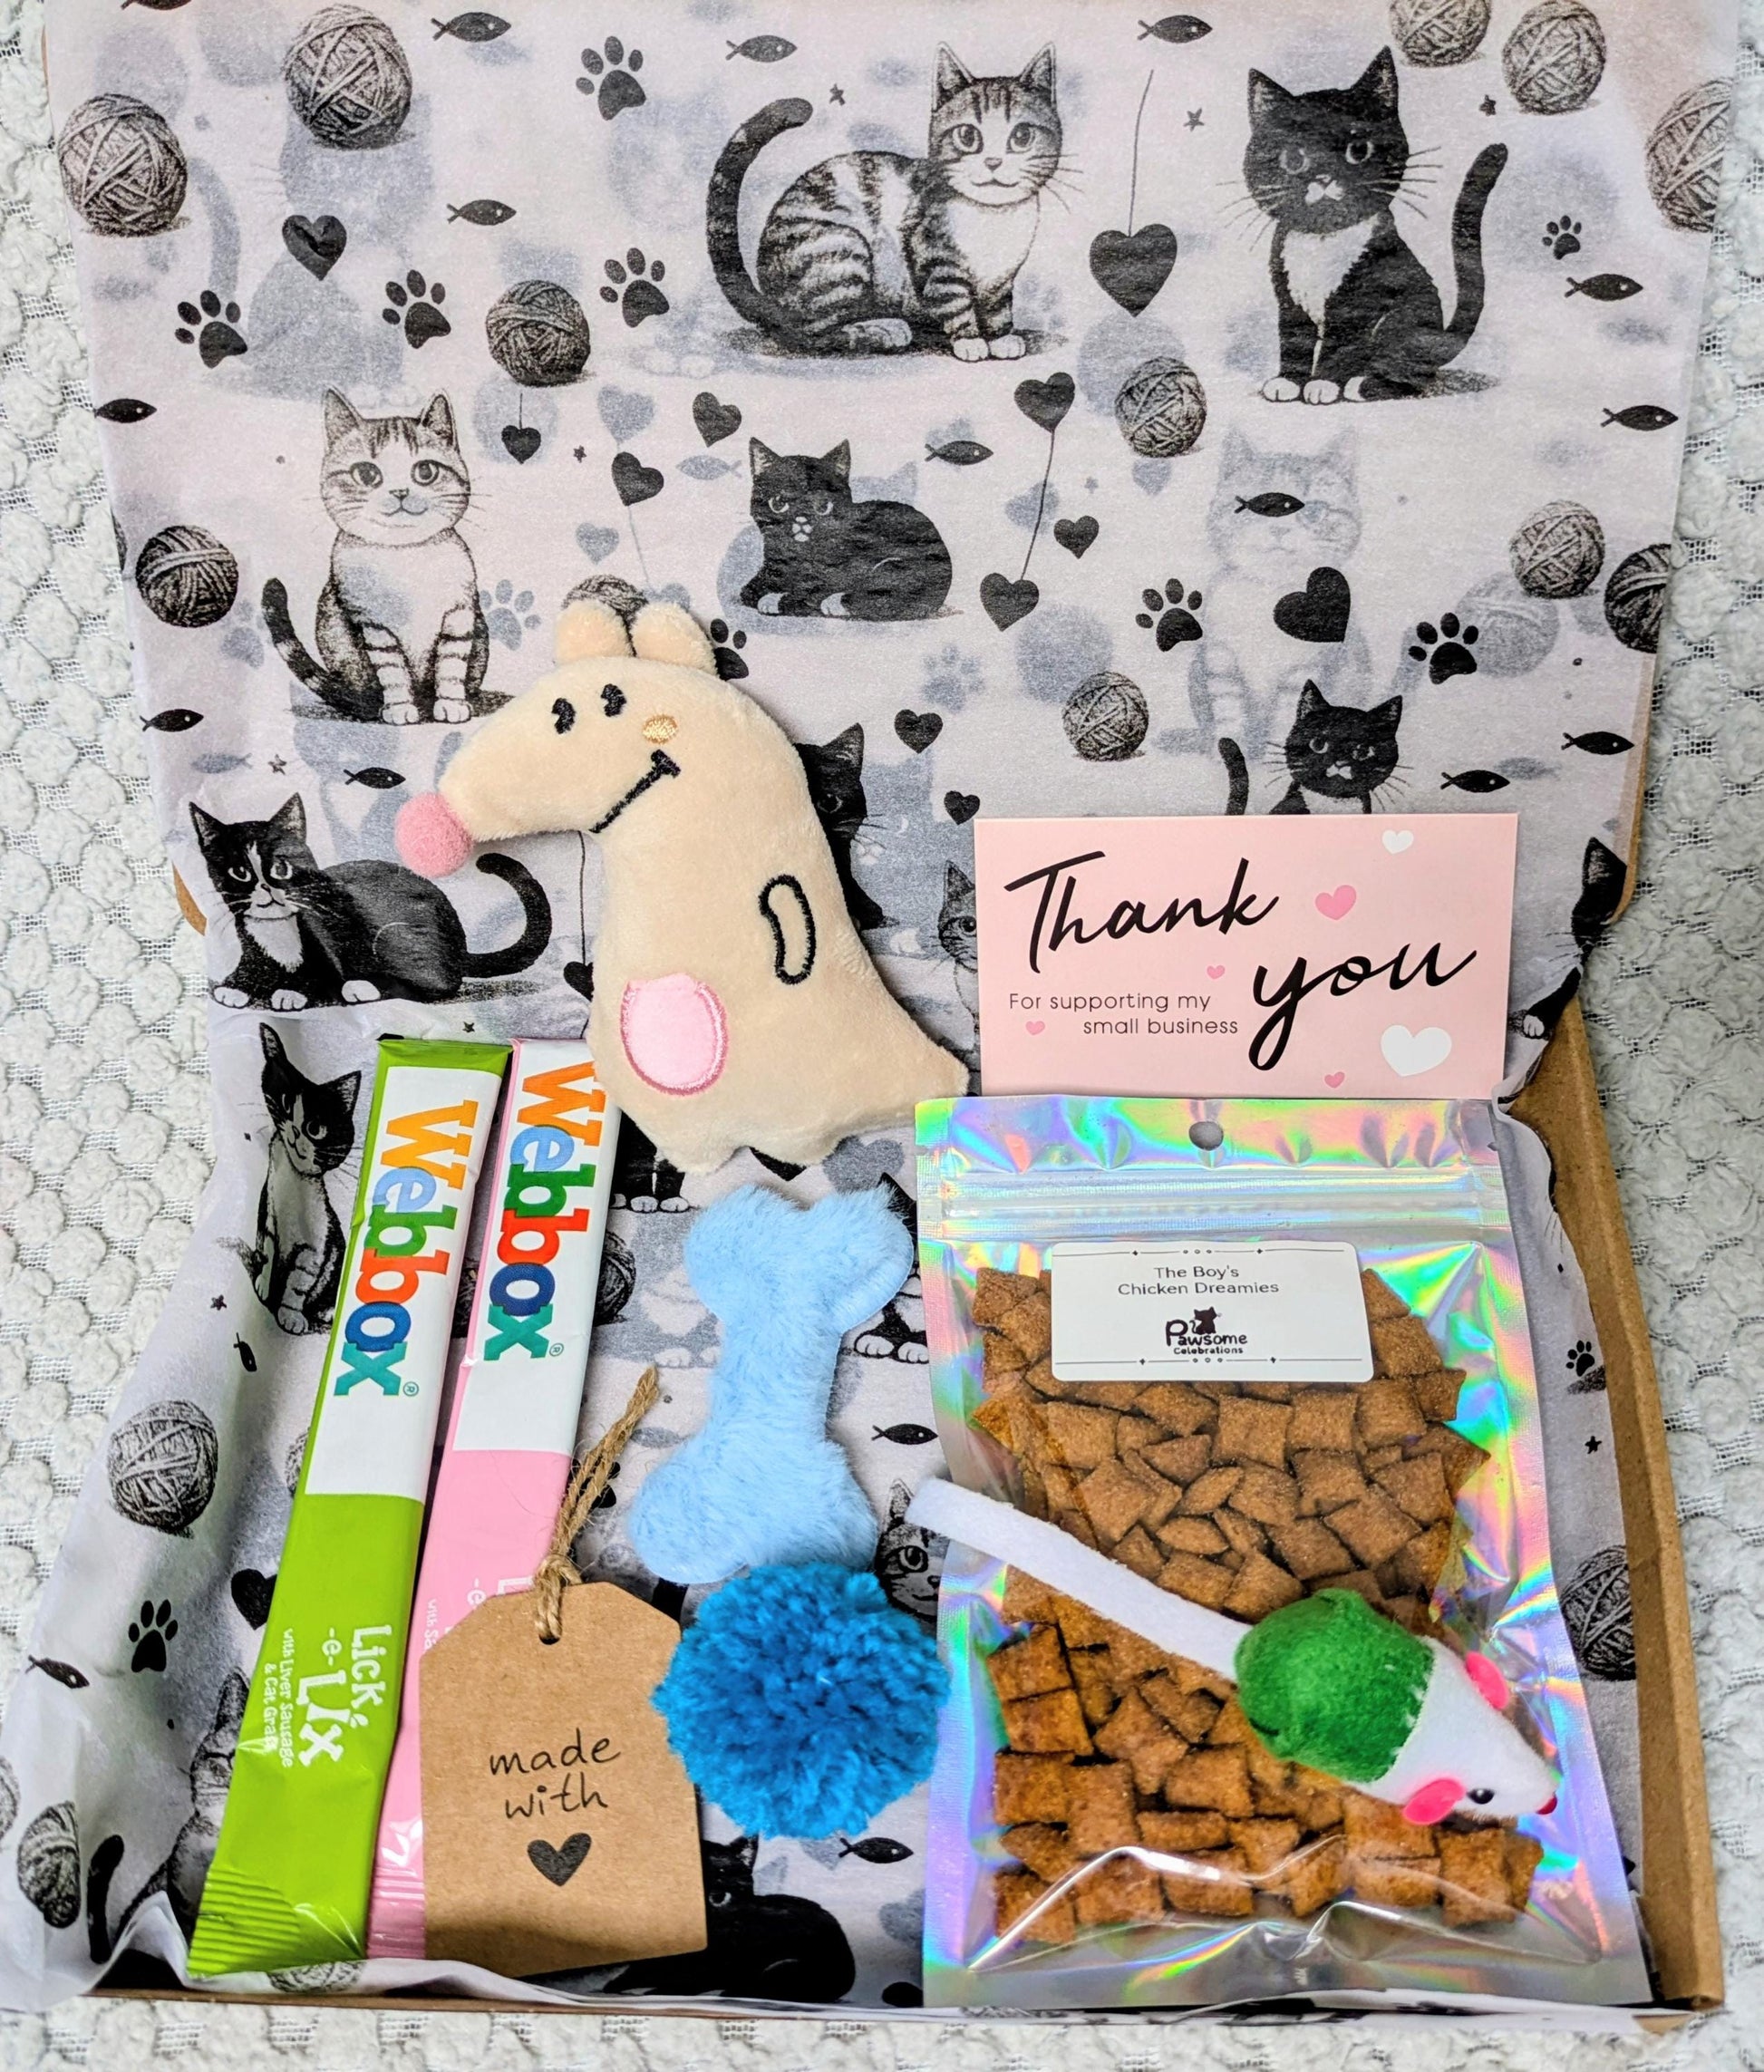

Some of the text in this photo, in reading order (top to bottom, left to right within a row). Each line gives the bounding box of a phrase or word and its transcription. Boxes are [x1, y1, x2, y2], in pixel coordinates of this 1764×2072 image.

[1003, 850, 1279, 973] Thank
[1009, 992, 1211, 1013] For supporting my
[1248, 943, 1478, 1071] you
[1083, 1017, 1238, 1035] small business
[1153, 1265, 1239, 1280] The Boy's
[1118, 1282, 1279, 1295] Chicken Dreamies
[1166, 1318, 1247, 1347] Pawsome
[1173, 1347, 1244, 1355] Celebrations
[425, 1598, 438, 1628] with
[265, 1662, 277, 1675] &
[351, 1624, 393, 1709] Lick
[263, 1677, 279, 1705] Cat
[279, 1628, 295, 1767] with Liver Sausage
[489, 1727, 621, 1776] made
[505, 1771, 608, 1818] with
